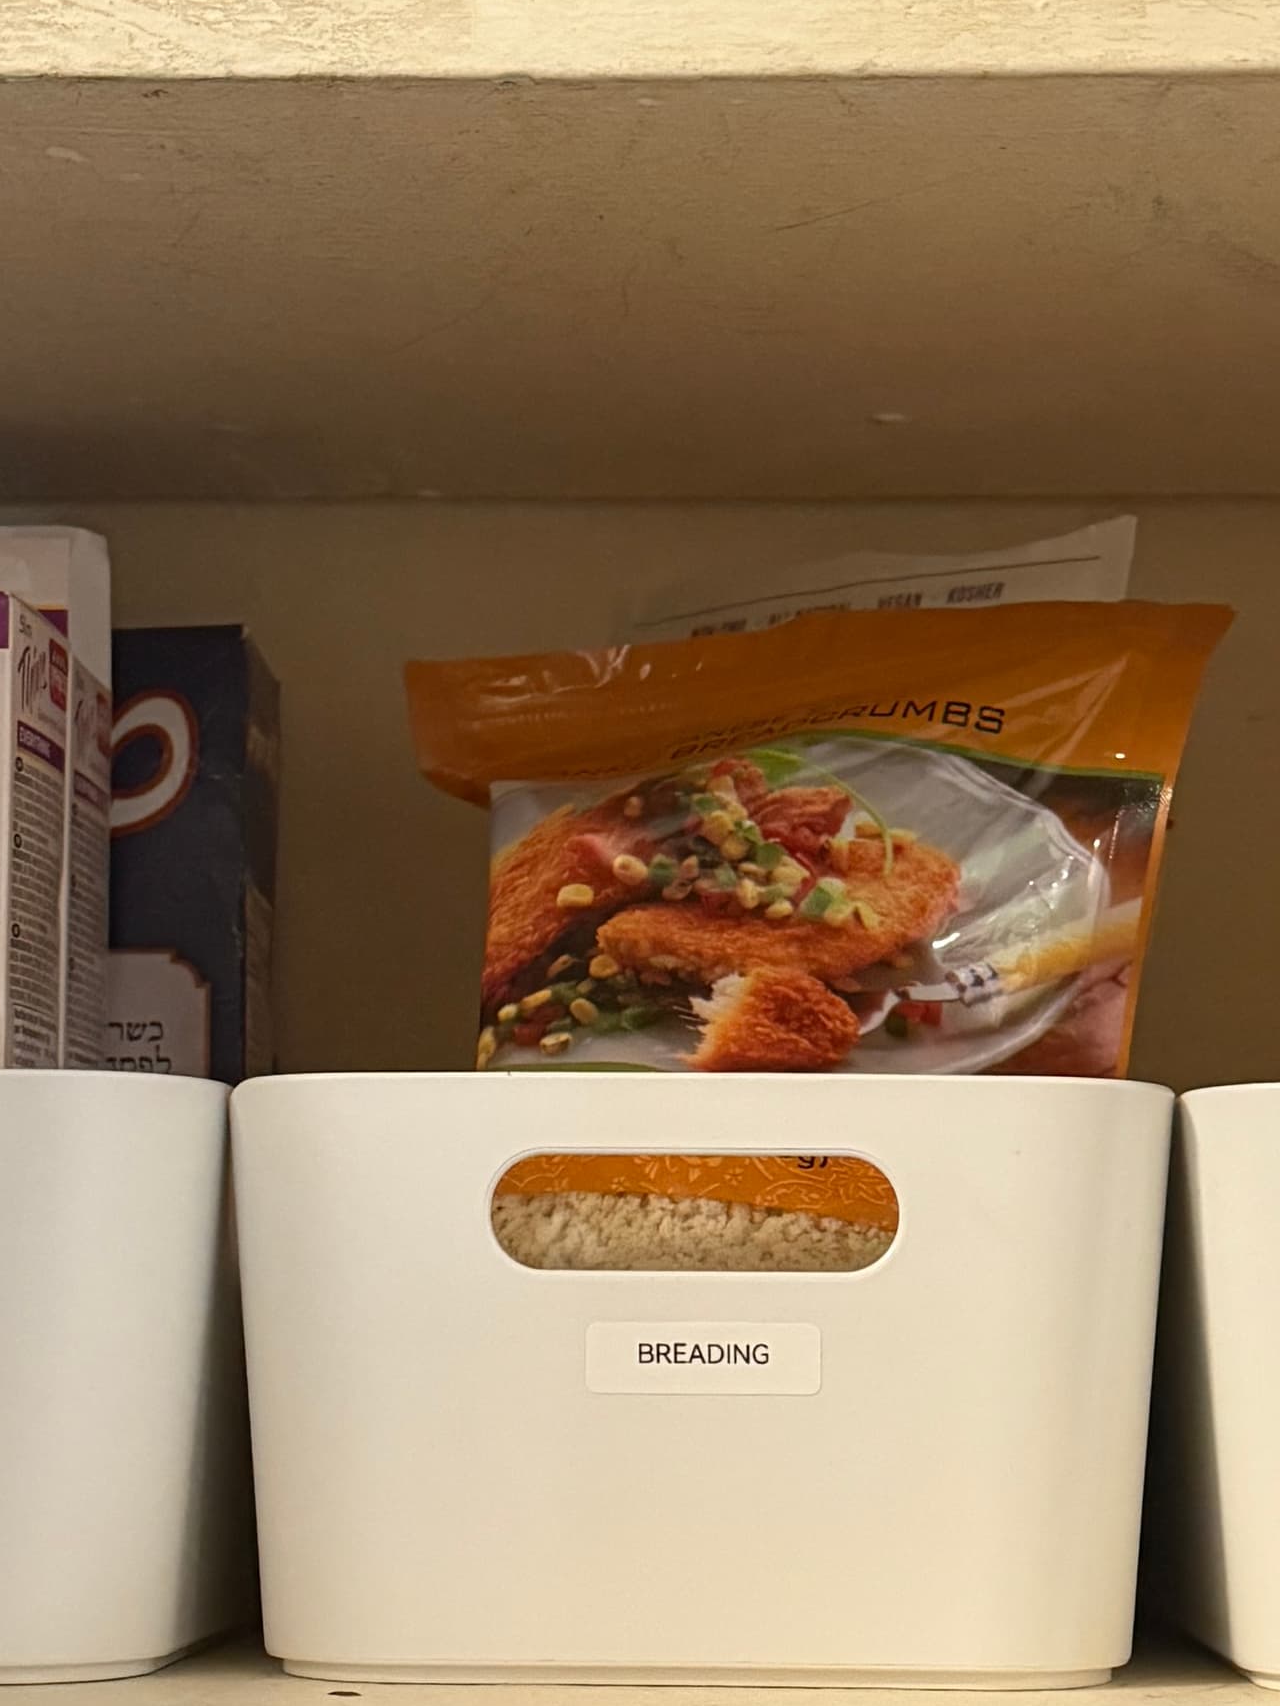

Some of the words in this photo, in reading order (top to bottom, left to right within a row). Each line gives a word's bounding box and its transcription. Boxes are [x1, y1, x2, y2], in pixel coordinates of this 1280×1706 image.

[946, 580, 1006, 605] KOSHER
[107, 1019, 164, 1044] כשר
[637, 1342, 771, 1366] BREADING
